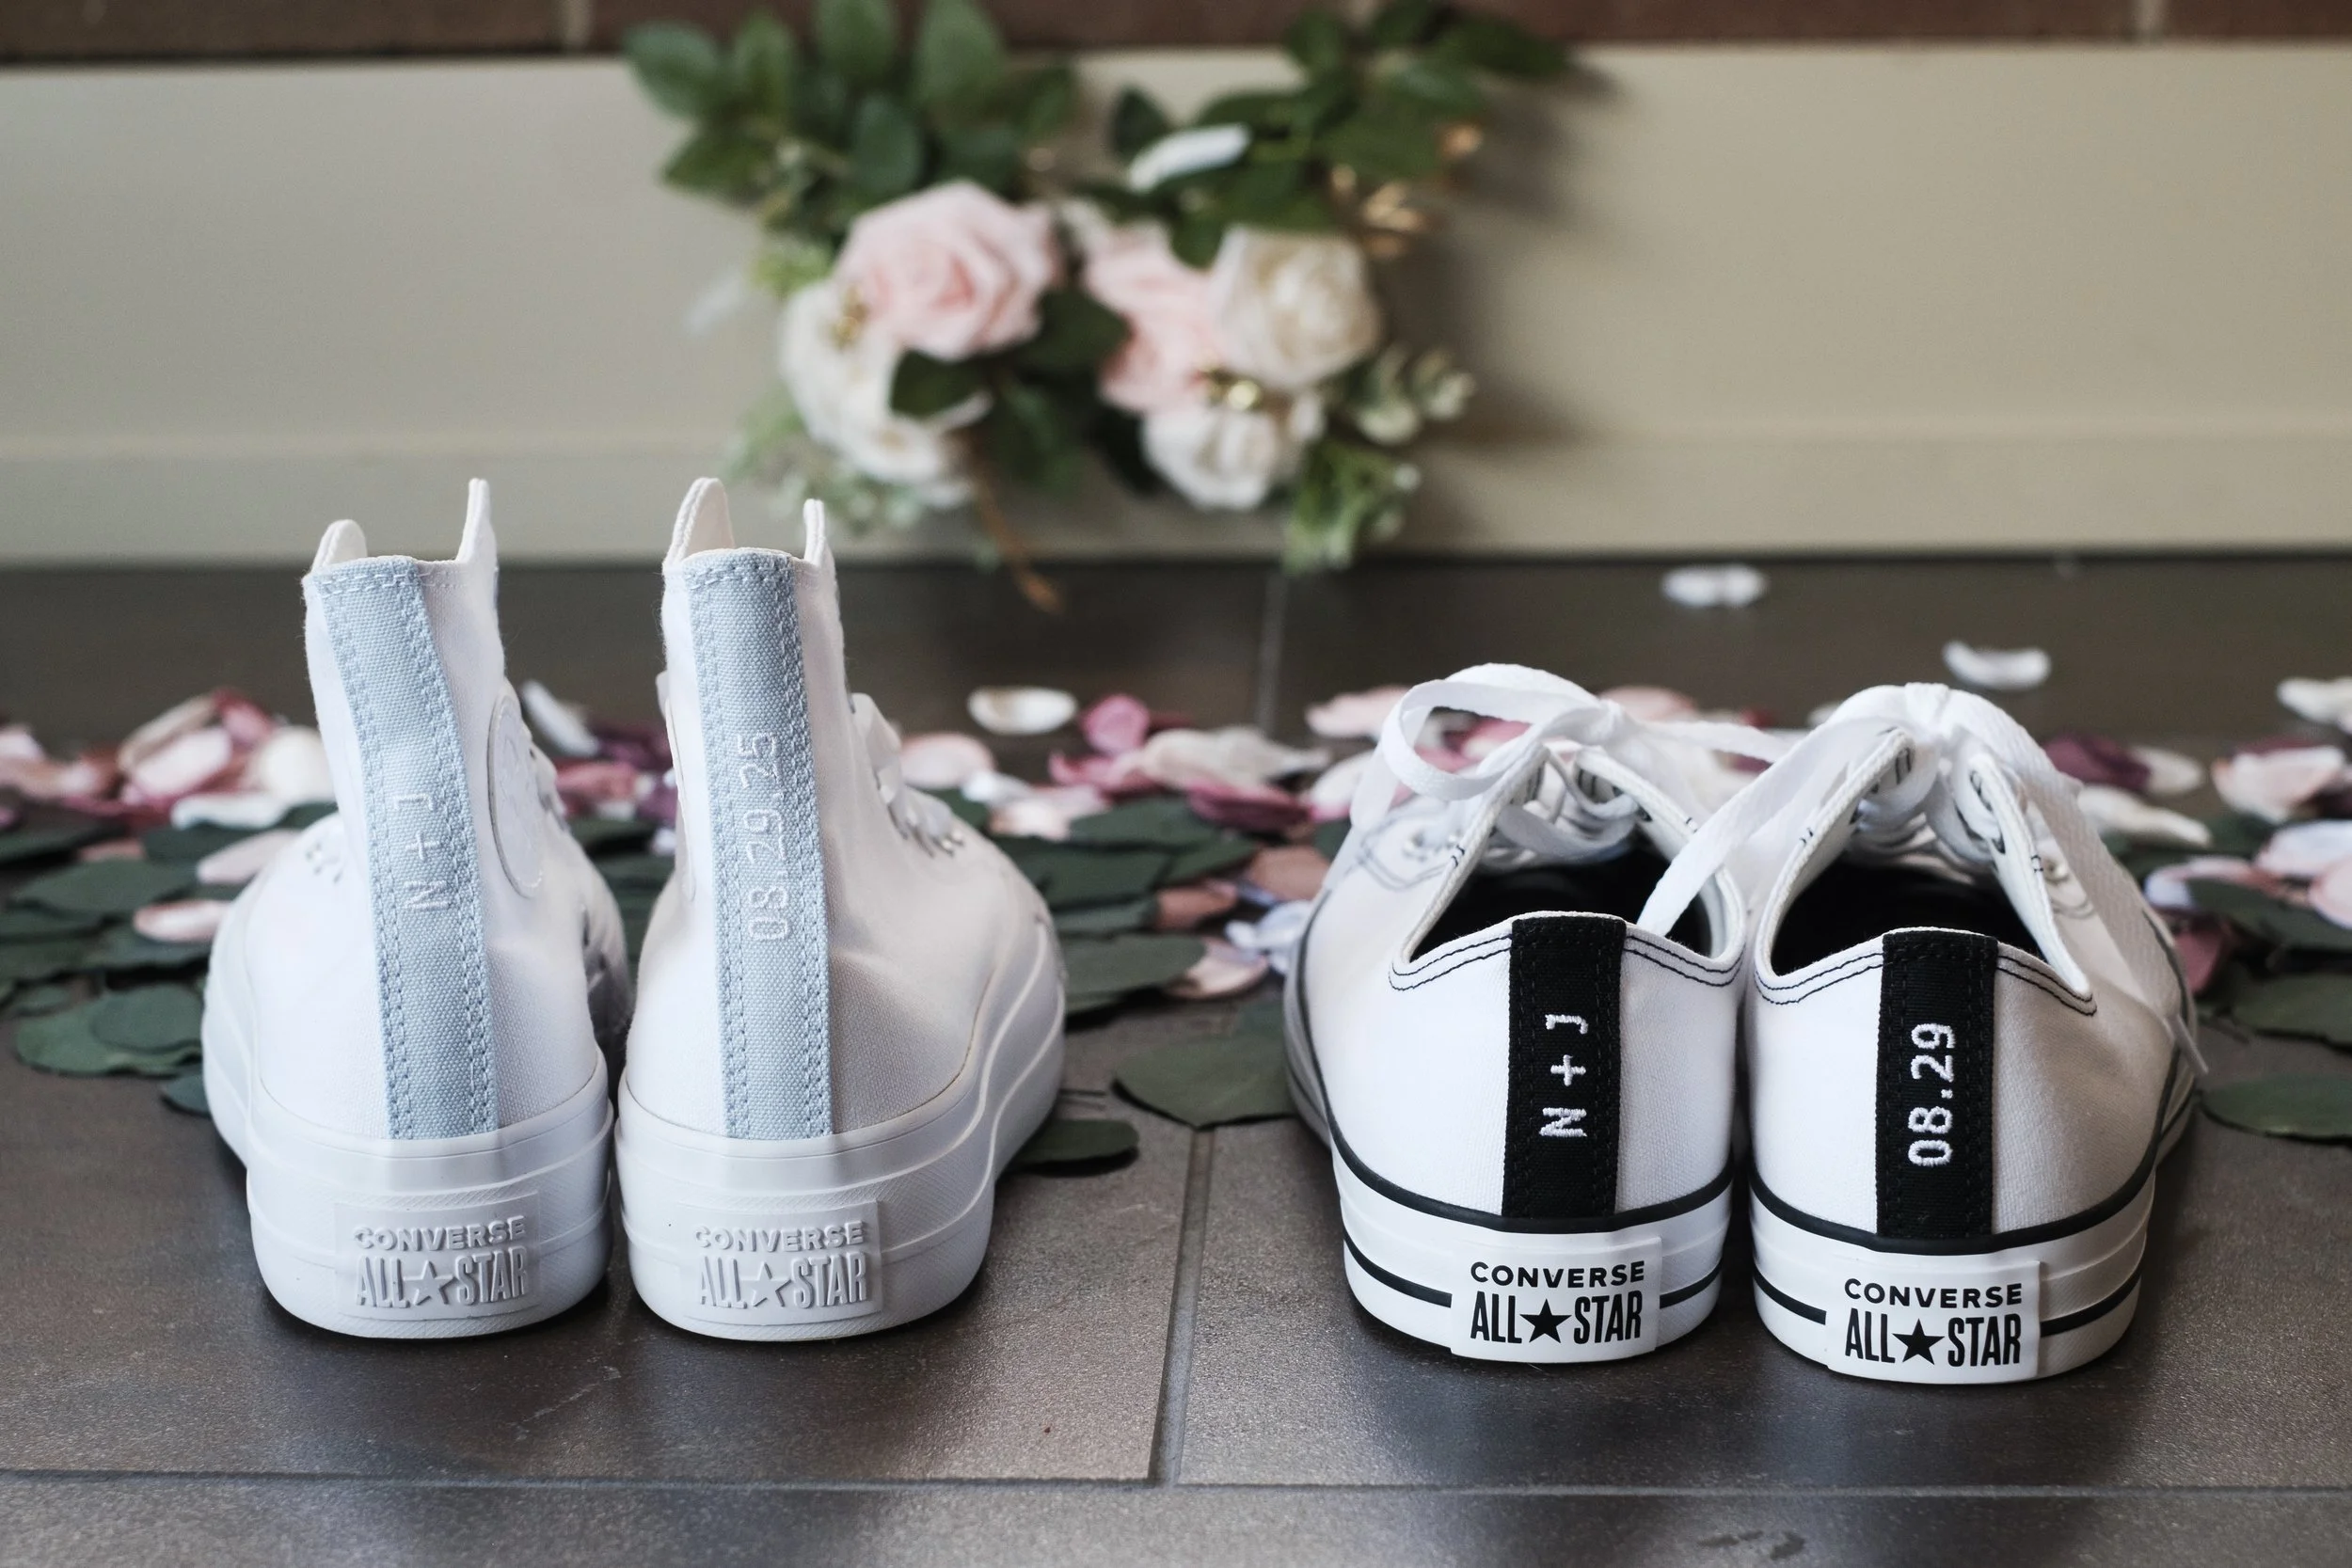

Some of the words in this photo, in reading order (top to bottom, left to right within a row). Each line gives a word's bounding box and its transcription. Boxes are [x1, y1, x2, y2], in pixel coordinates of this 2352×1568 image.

[394, 793, 433, 812] J
[404, 879, 448, 911] N
[1545, 1014, 1588, 1034] J
[1550, 1054, 1586, 1086] +
[1908, 1022, 1956, 1166] 08.29
[1539, 1107, 1587, 1137] N
[353, 1214, 526, 1252] CONVERSE
[692, 1220, 865, 1253] CONVERSE
[356, 1255, 410, 1307] ALL
[454, 1245, 527, 1306] STAR
[698, 1256, 748, 1308] ALL
[792, 1251, 866, 1308] STAR
[1470, 1260, 1645, 1290] CONVERSE
[1844, 1278, 2023, 1308] CONVERSE
[1470, 1290, 1522, 1343] ALL
[1572, 1290, 1643, 1344] STAR
[1844, 1308, 1895, 1362] ALL
[1947, 1313, 2021, 1366] STAR
